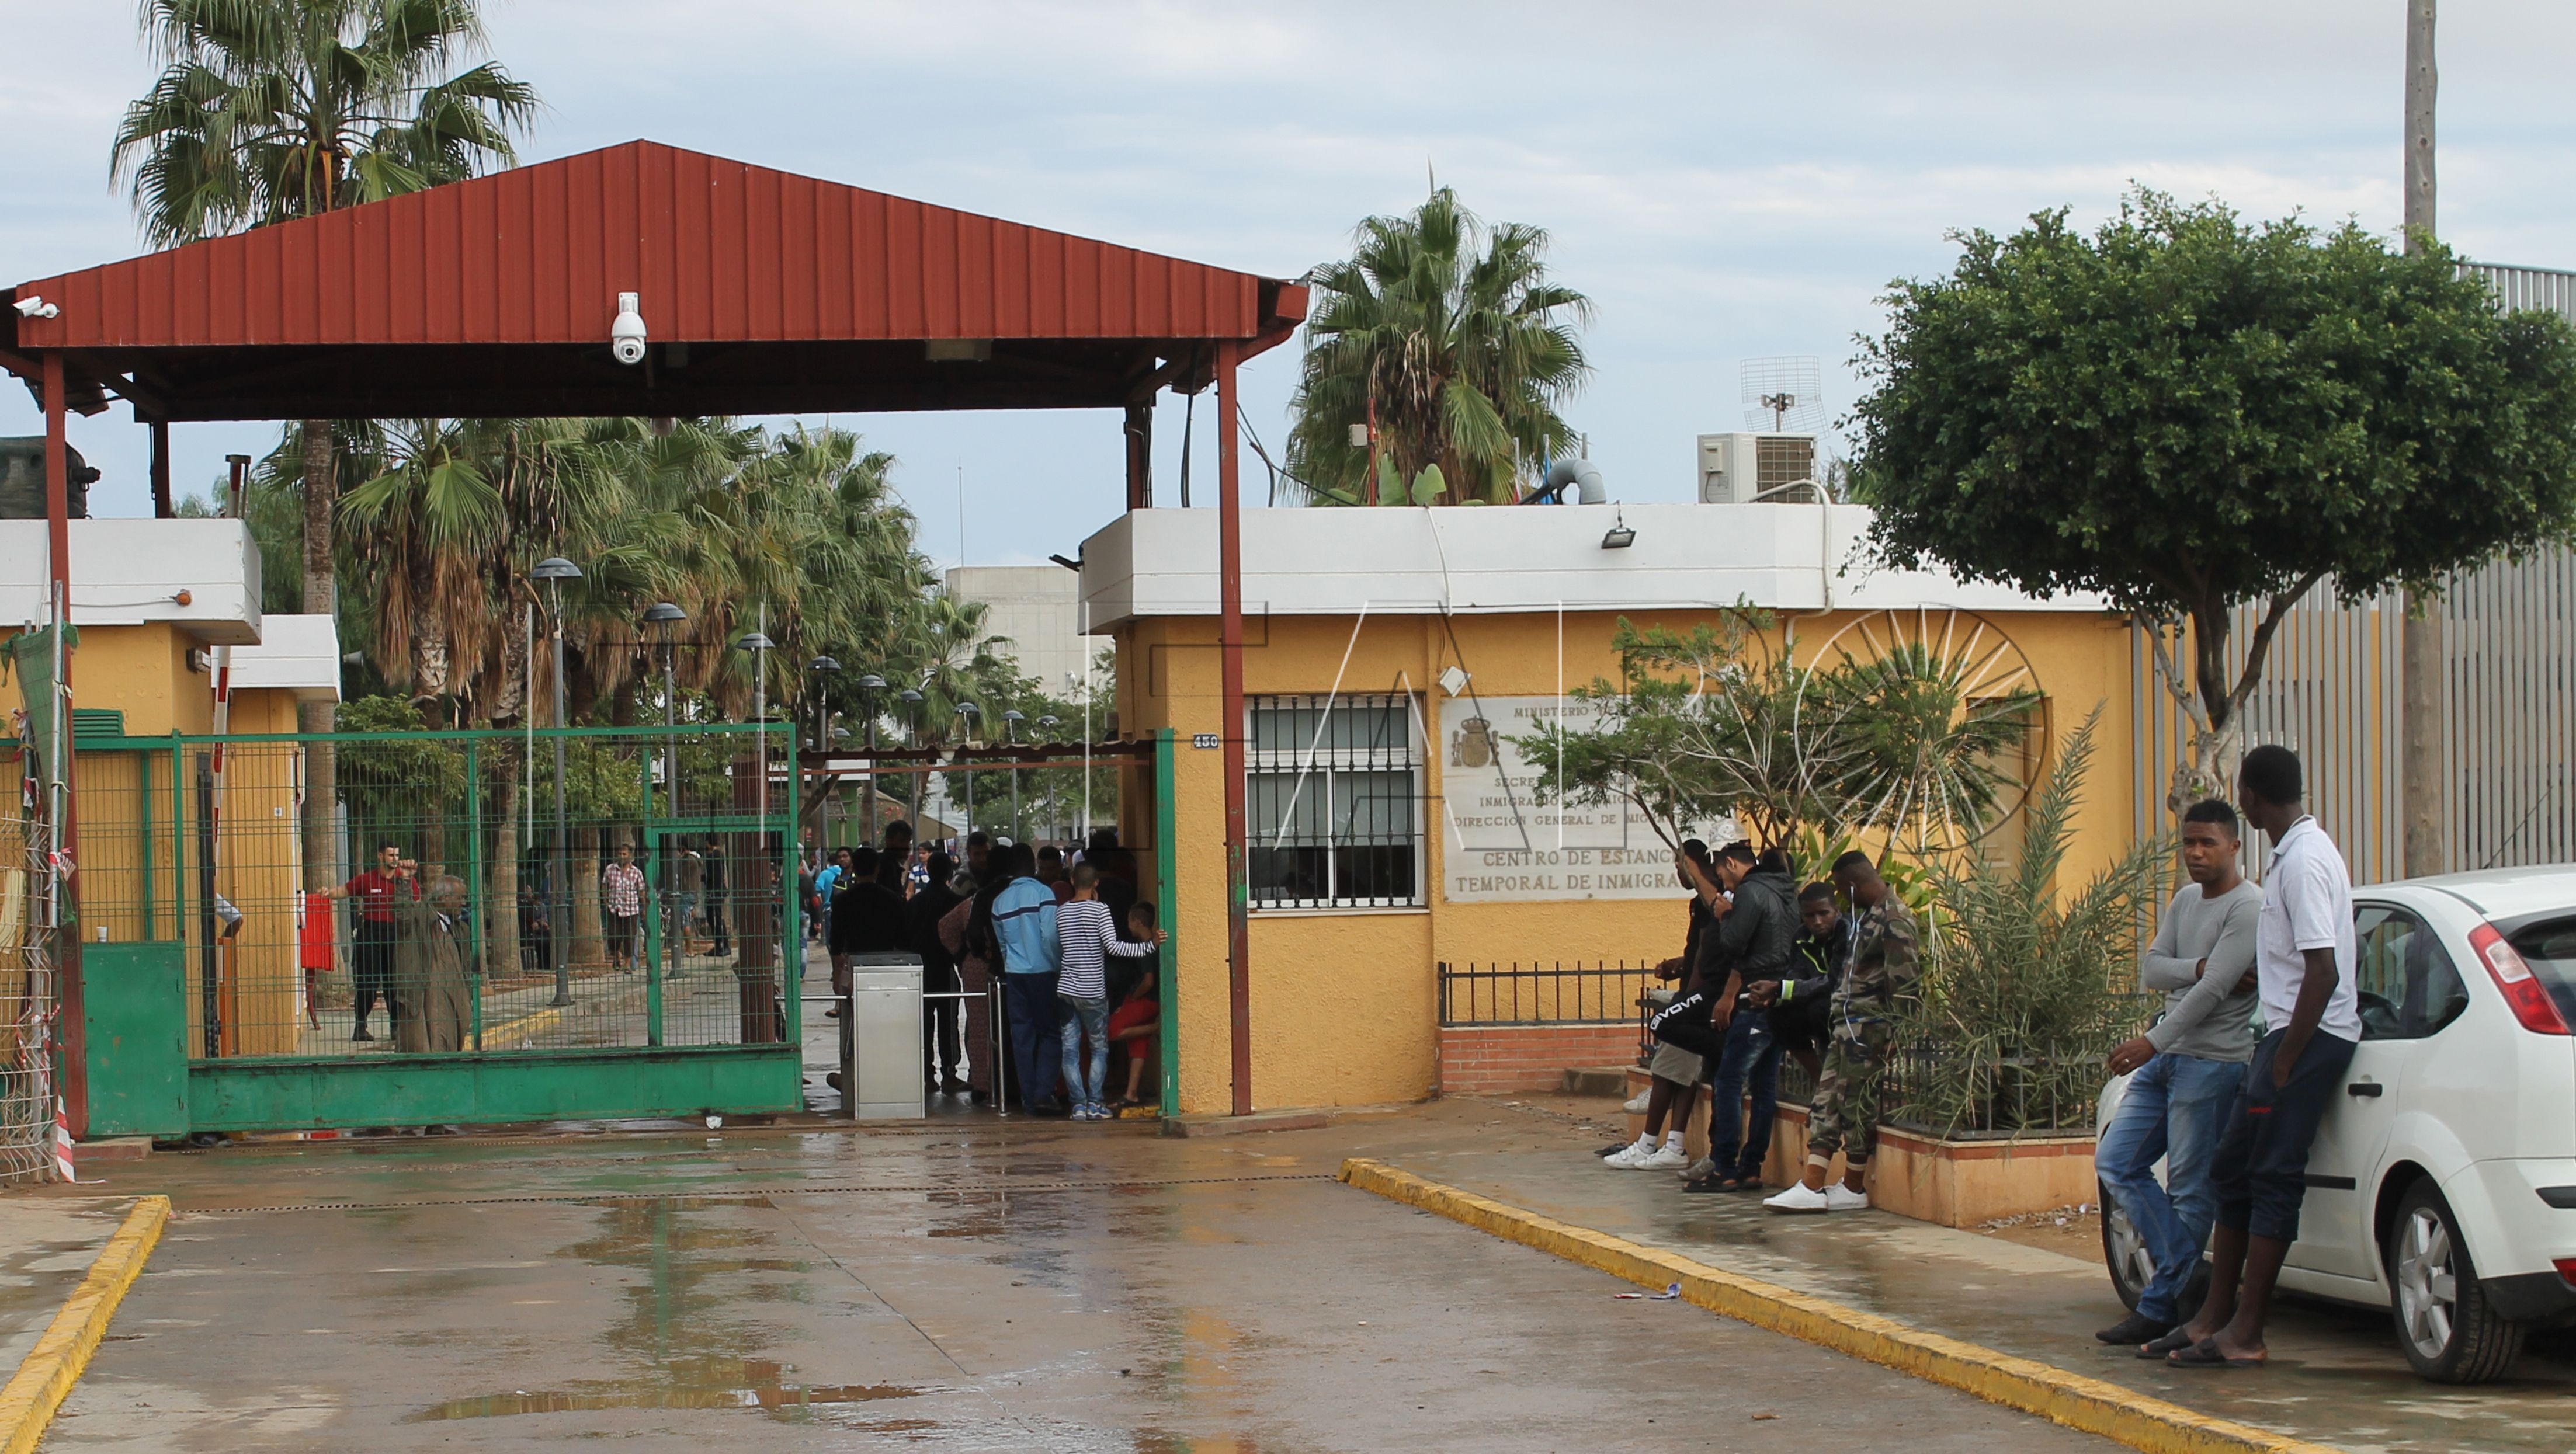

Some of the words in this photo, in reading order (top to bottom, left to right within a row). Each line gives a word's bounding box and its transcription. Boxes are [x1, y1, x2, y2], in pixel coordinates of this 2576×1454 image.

[1513, 706, 1589, 718] MINISTERIO
[1193, 736, 1218, 747] 450
[1494, 776, 1537, 788] SECRE
[1535, 815, 1593, 826] GENERAL
[1601, 814, 1616, 825] DE
[1483, 850, 1560, 867] CENTRO
[1567, 850, 1592, 865] DE
[1455, 875, 1560, 892] TEMPORAL
[1567, 874, 1591, 890] DE
[1598, 873, 1680, 889] INMIGRA
[1650, 993, 1703, 1031] GIVOVA
